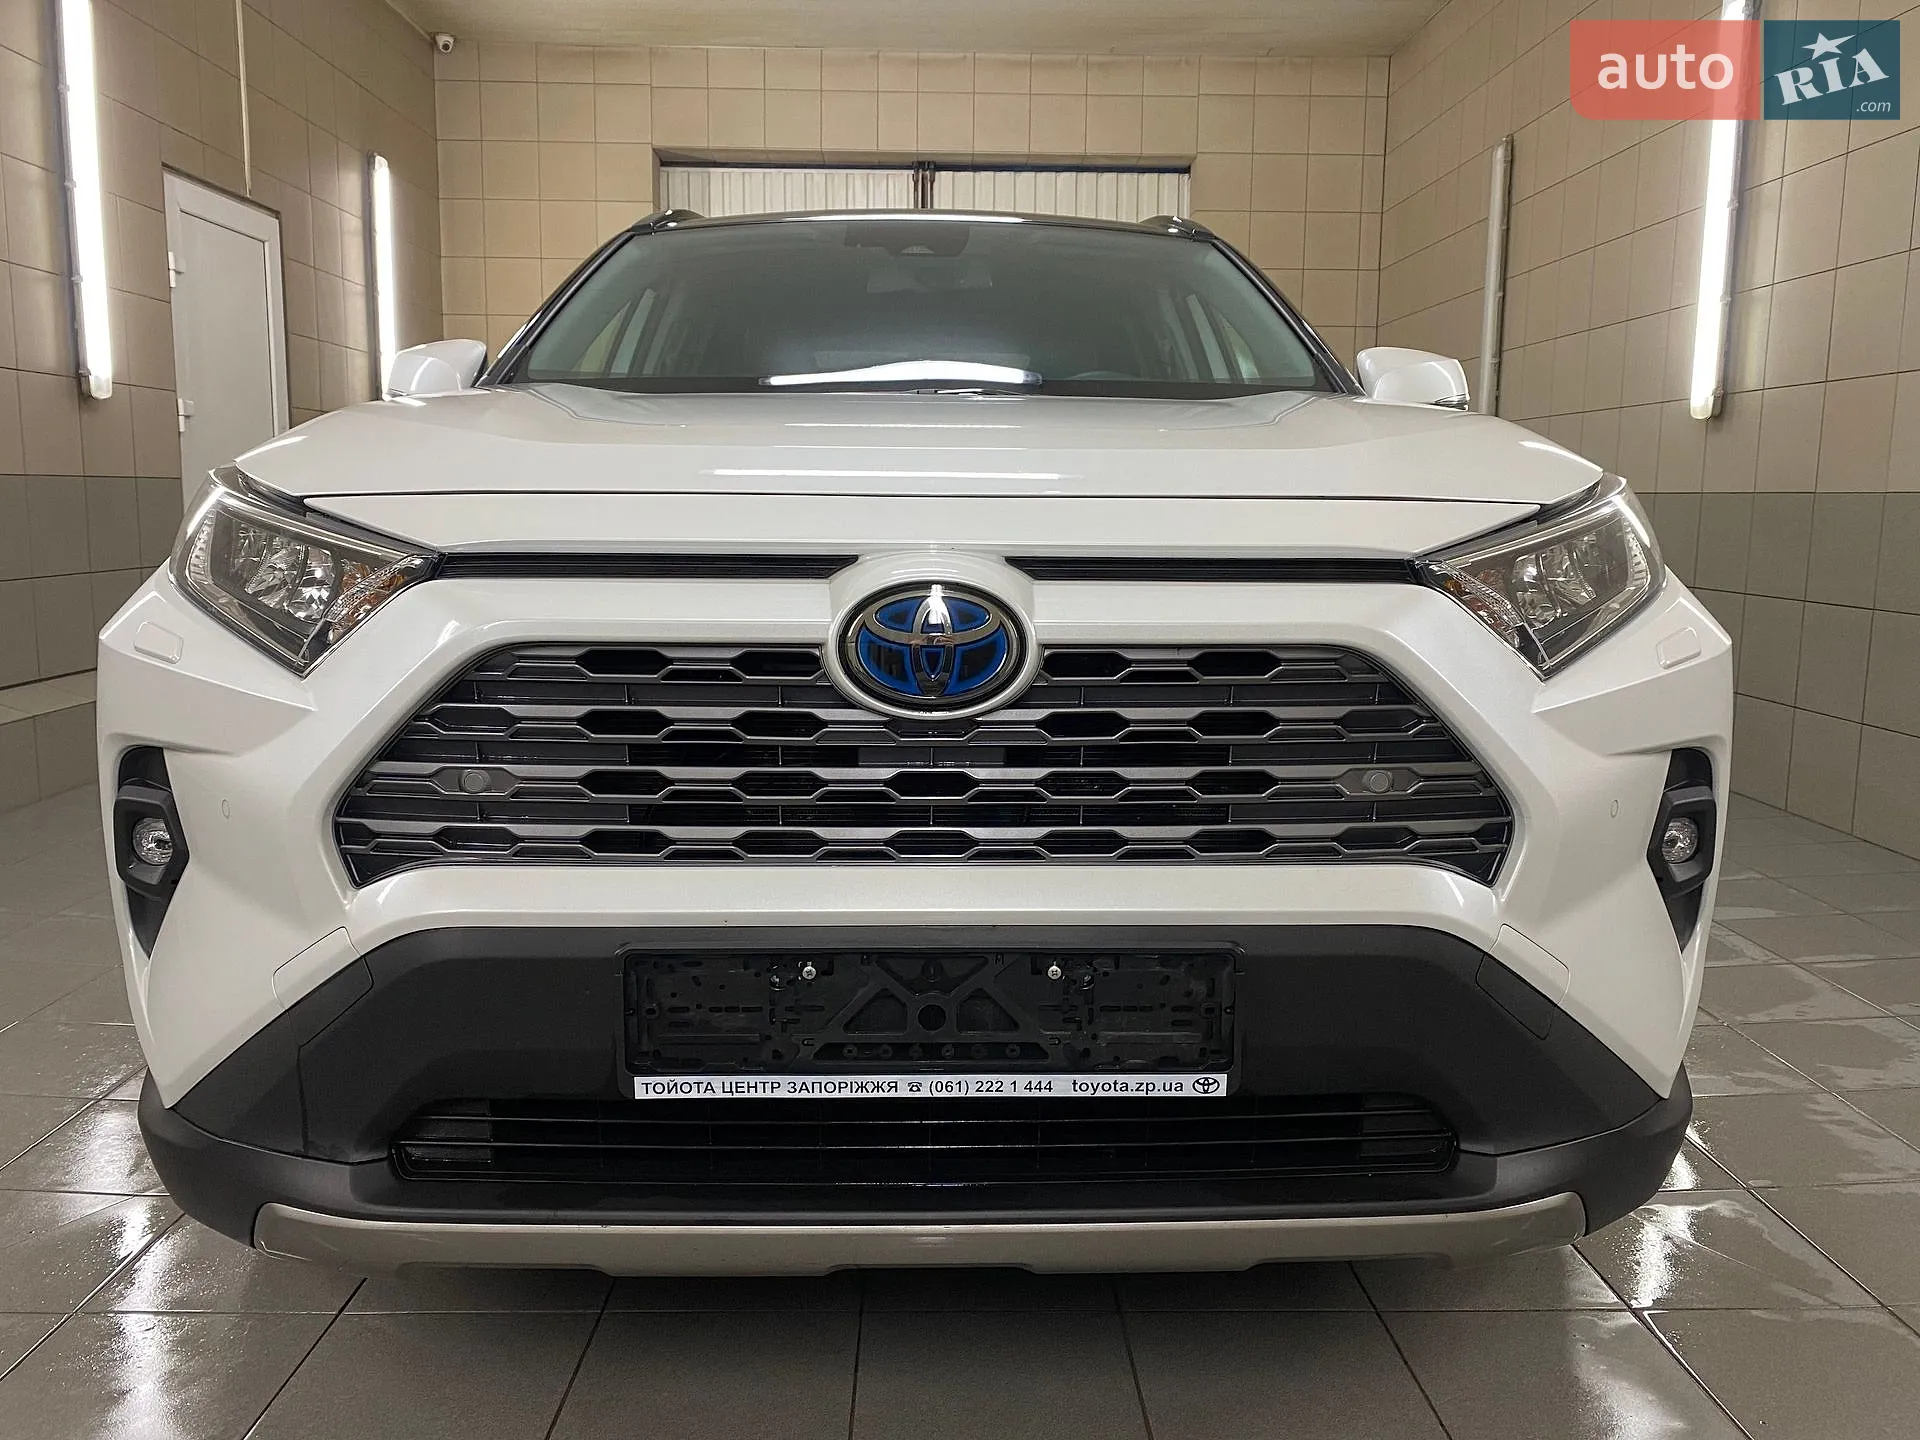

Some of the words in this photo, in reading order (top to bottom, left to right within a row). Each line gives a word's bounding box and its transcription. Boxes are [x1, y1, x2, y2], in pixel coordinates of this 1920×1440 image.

[641, 1080, 716, 1095] ТОЙОТА
[721, 1080, 782, 1096] ЦЕНТР
[787, 1081, 898, 1094] ЗАПОРІЖЖЯ
[929, 1080, 970, 1096] (061)
[975, 1080, 1004, 1093] 222
[1010, 1080, 1018, 1093] 1
[1023, 1080, 1054, 1093] 444
[1072, 1079, 1184, 1095] toyota.zp.ua
